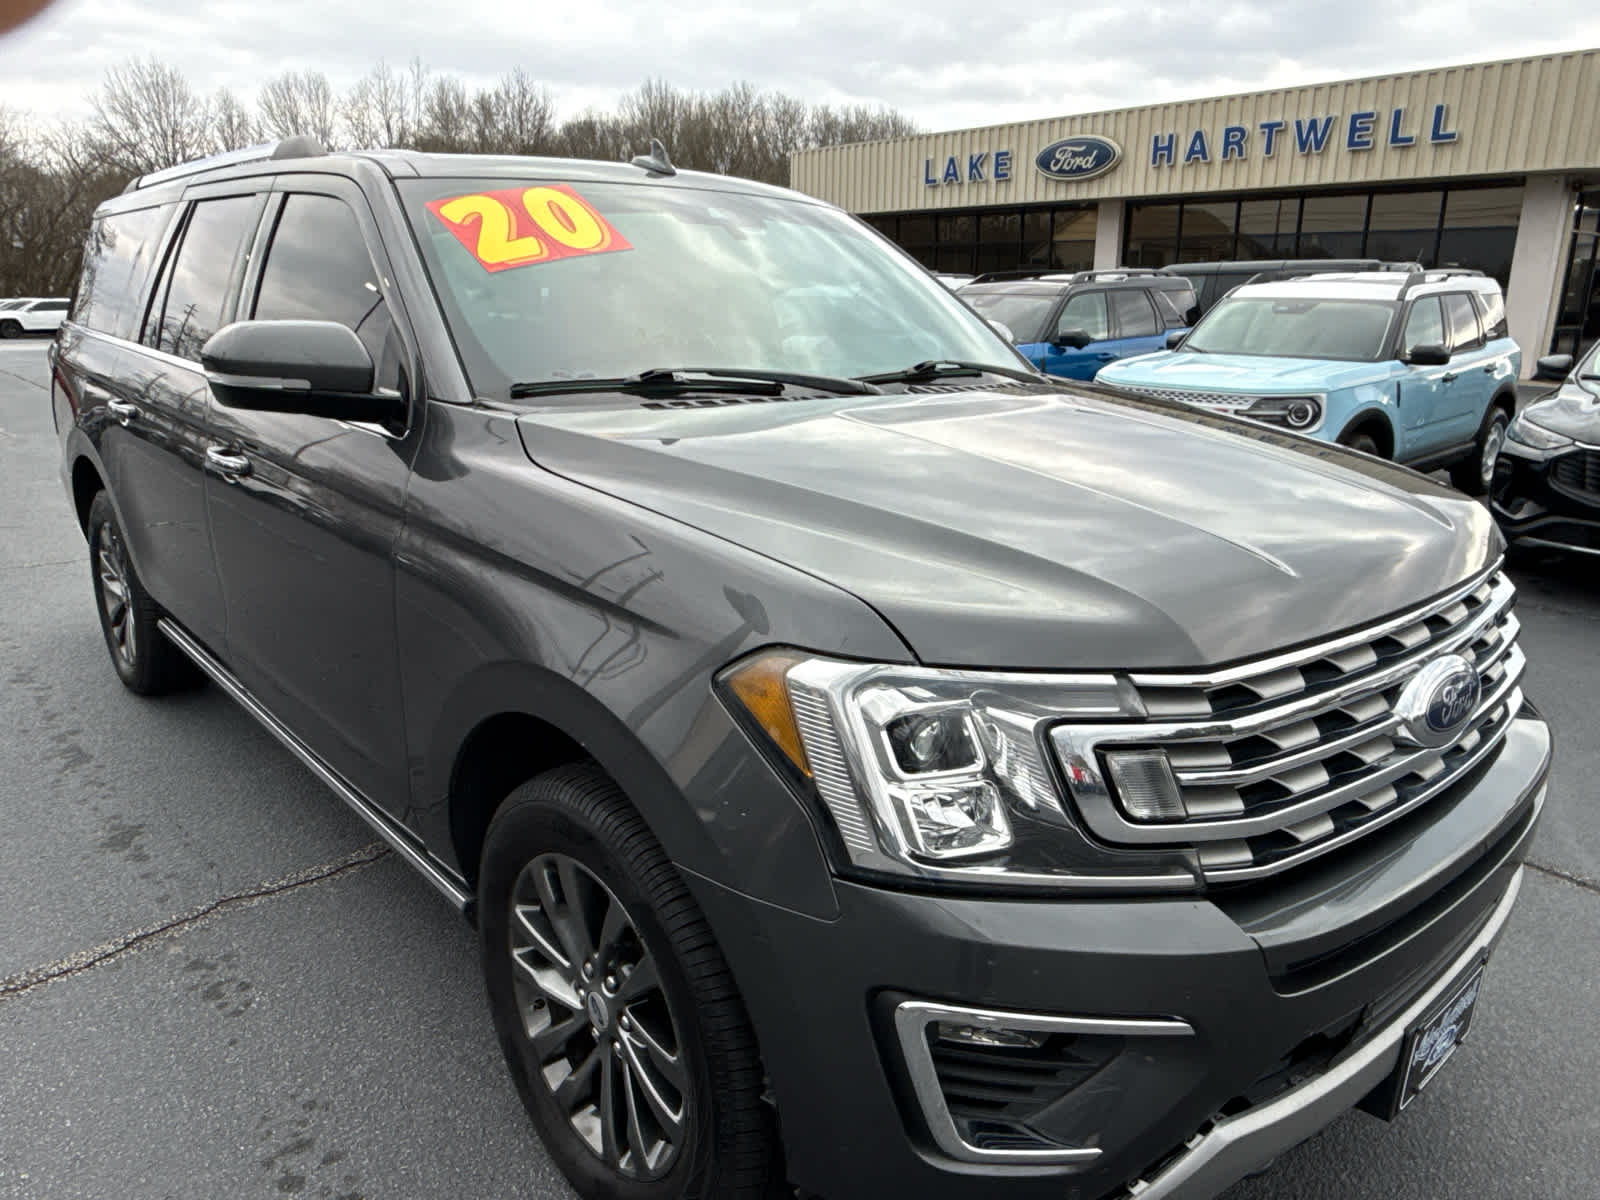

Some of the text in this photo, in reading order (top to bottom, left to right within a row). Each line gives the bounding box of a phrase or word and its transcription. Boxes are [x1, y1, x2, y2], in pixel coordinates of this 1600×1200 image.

[924, 103, 1460, 187] LAKE Ford HARTWELL
[439, 186, 612, 265] 20
[1442, 680, 1474, 725] Ford
